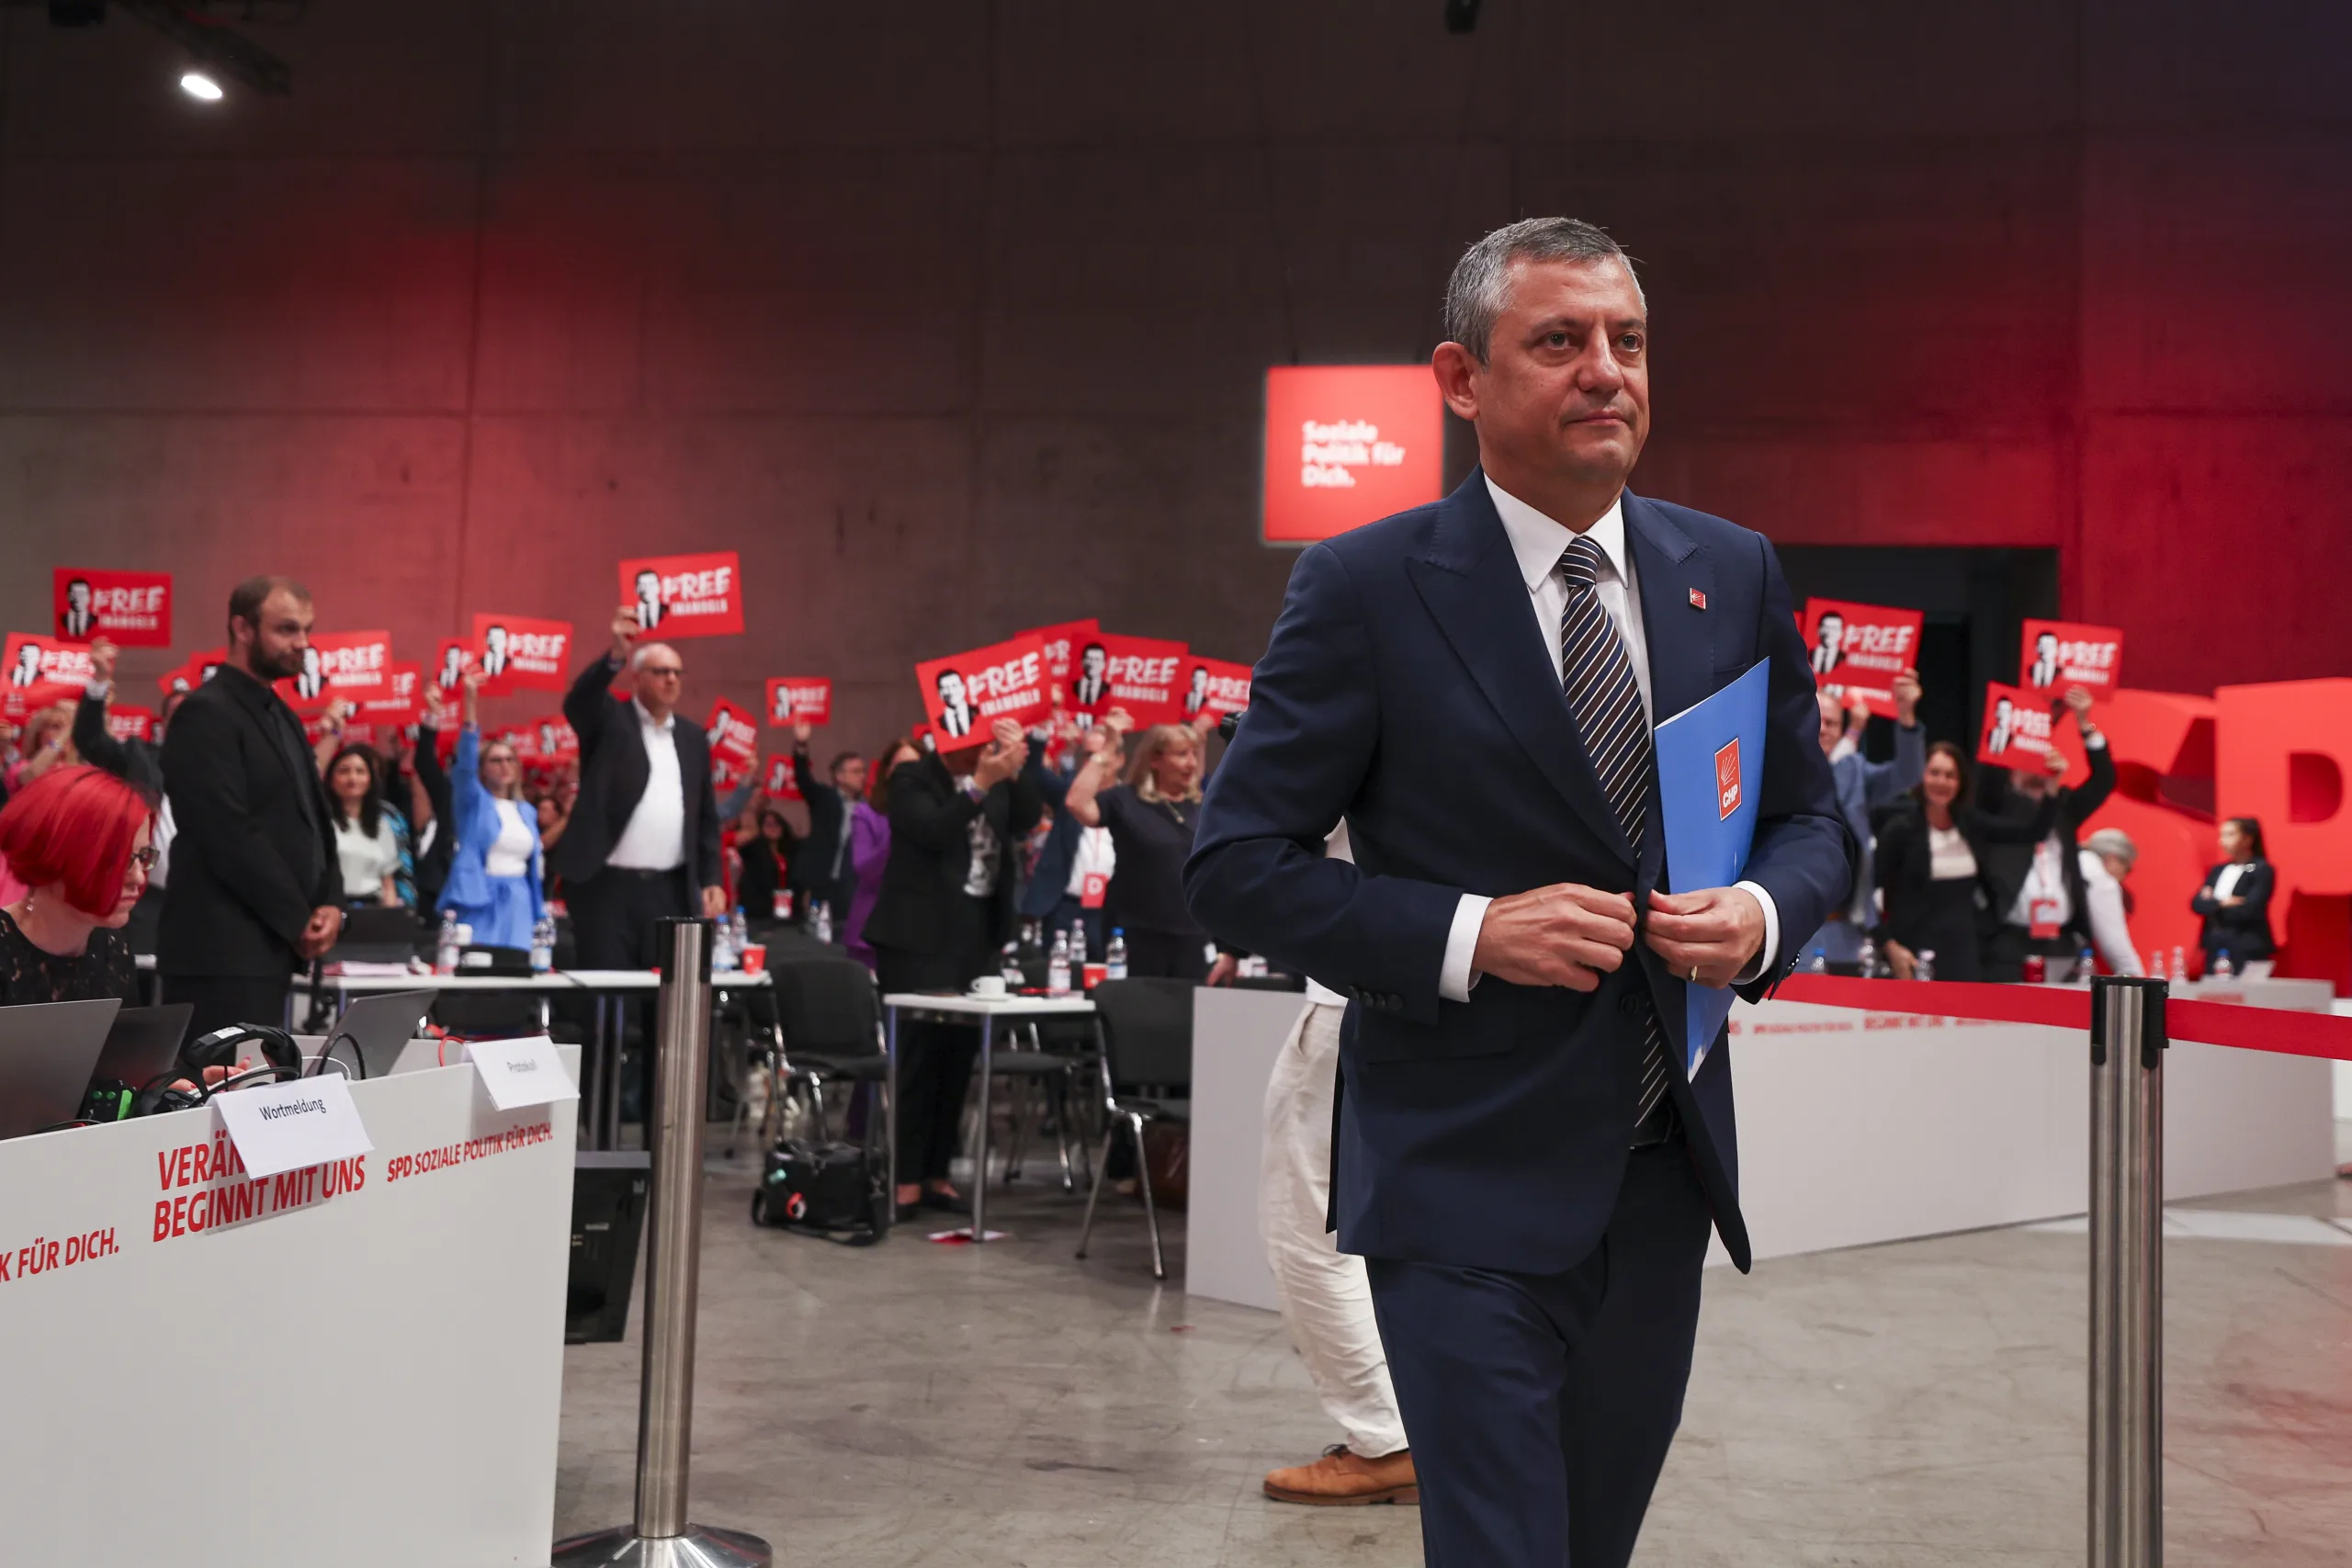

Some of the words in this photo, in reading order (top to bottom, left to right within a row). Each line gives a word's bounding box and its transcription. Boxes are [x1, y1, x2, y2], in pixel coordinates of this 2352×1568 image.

[662, 566, 731, 604] FREE
[94, 585, 165, 615] FREE
[507, 633, 566, 658] FREE
[1044, 640, 1070, 662] FR
[1842, 624, 1915, 653] FREE
[42, 650, 95, 674] FRE
[322, 643, 385, 675] FREE
[2058, 641, 2118, 668] FREE
[967, 651, 1040, 705] FREE
[1106, 656, 1180, 683] FREE
[1207, 675, 1250, 700] FRE
[1723, 784, 1738, 808] CHP
[259, 1099, 326, 1121] Wortmeldung
[158, 1129, 246, 1190] VERÄN
[387, 1156, 413, 1183] SPD
[414, 1144, 460, 1175] SOZIALE
[463, 1134, 503, 1162] POLITIK
[505, 1124, 526, 1151] FÜR
[527, 1122, 553, 1145] DICH.
[153, 1178, 269, 1242] BEGINNT
[273, 1166, 318, 1212] MIT
[321, 1155, 365, 1199] UNS
[17, 1236, 60, 1279] FÜR
[65, 1227, 119, 1266] DICH.
